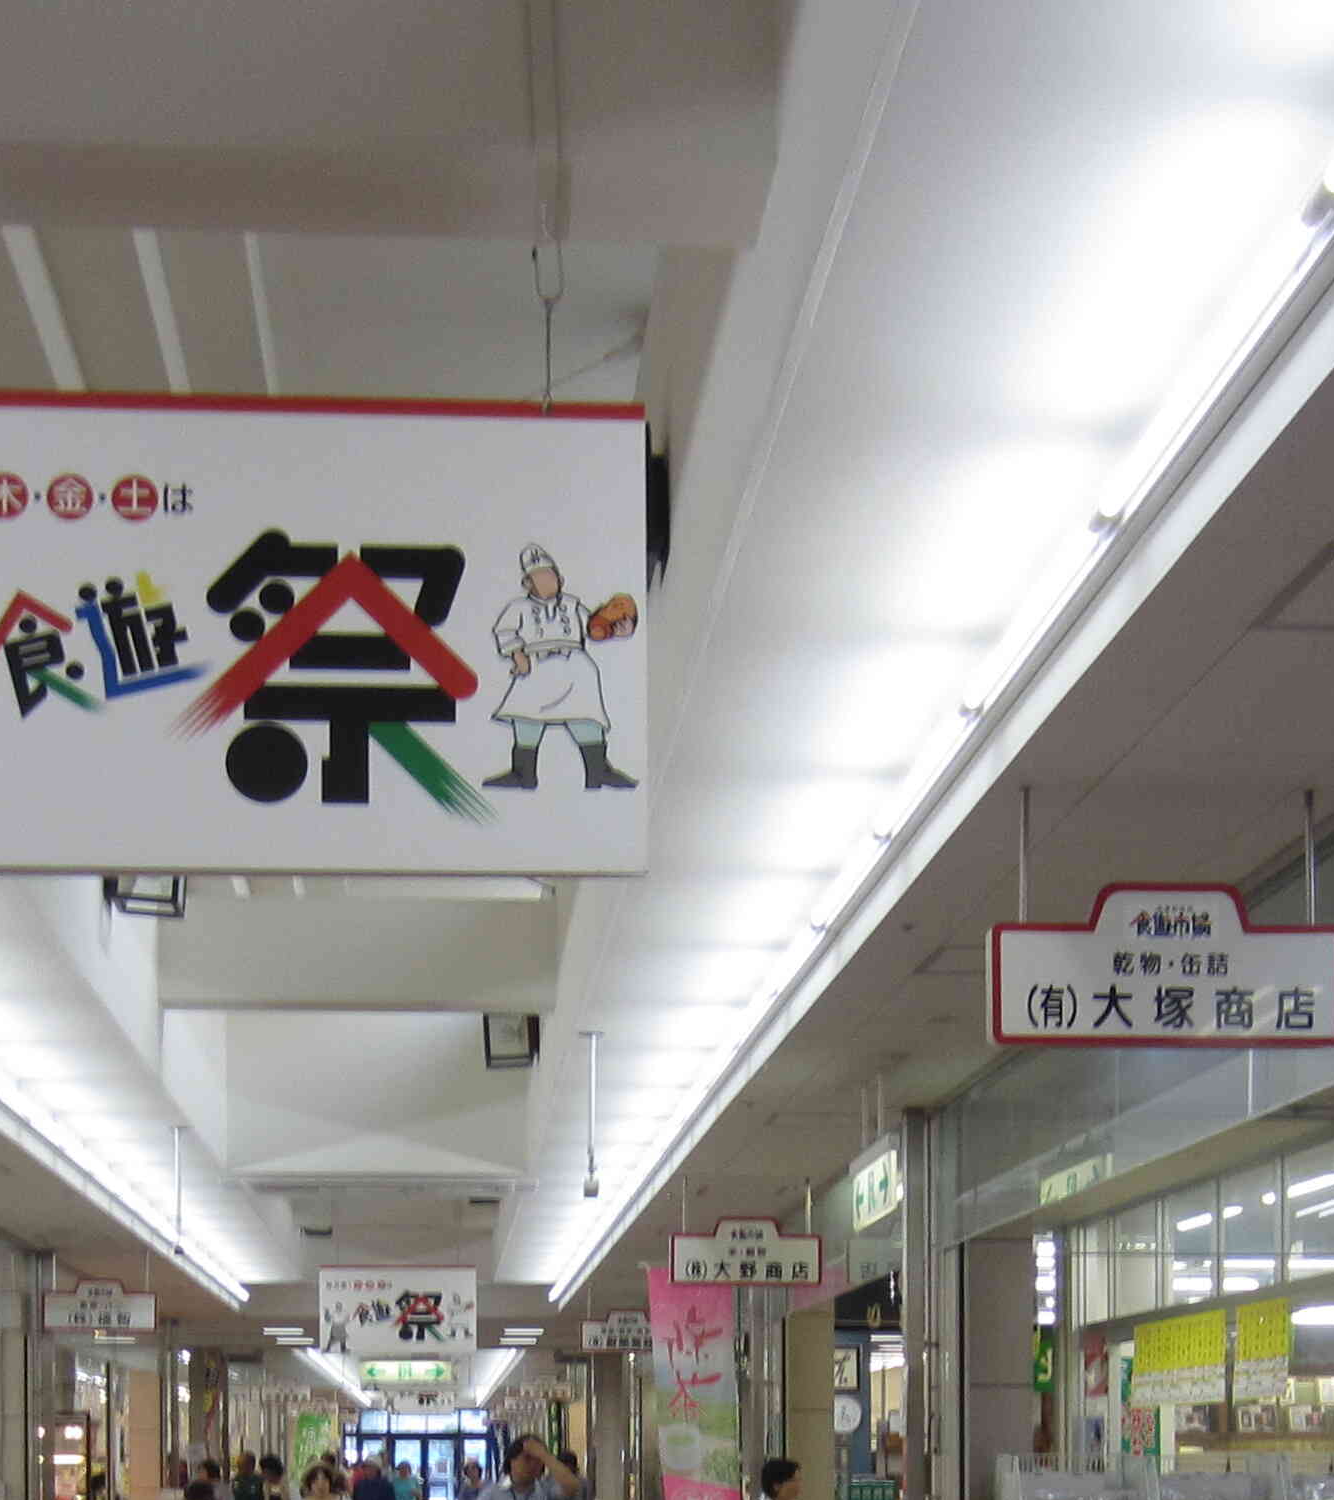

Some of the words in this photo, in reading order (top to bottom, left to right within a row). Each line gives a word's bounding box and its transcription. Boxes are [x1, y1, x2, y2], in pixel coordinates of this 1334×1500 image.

[1112, 952, 1229, 977] 乾物・缶詰
[1027, 982, 1316, 1031] (有)大塚商店
[685, 1259, 811, 1281] (株)大野商店
